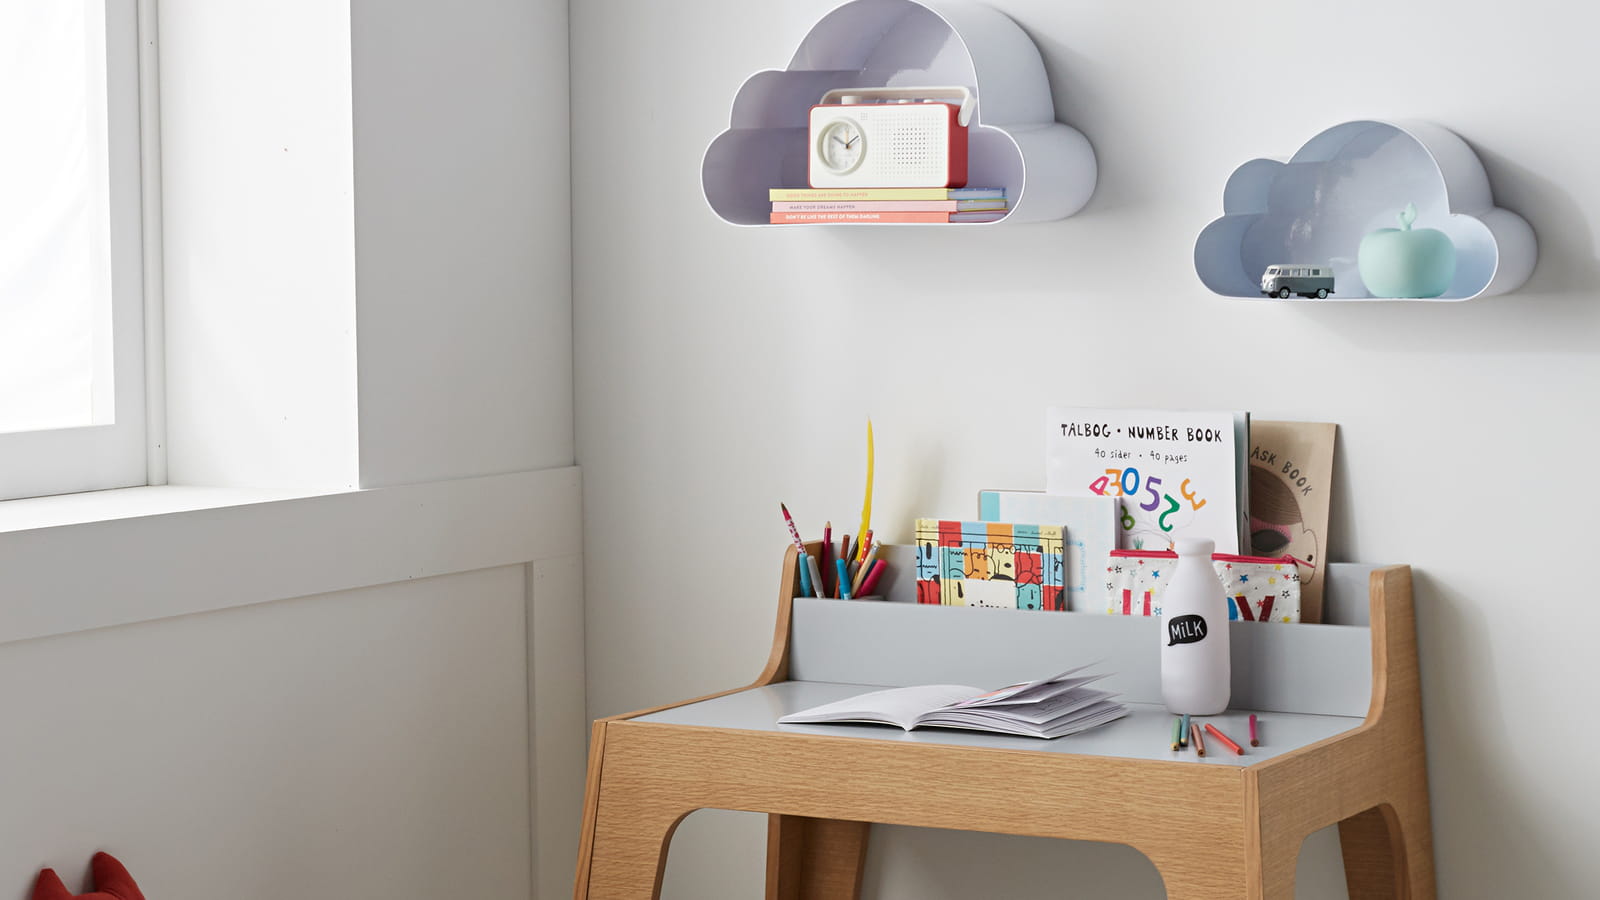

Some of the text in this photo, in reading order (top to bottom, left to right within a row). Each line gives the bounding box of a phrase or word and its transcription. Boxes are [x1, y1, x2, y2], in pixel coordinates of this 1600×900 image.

[1061, 423, 1222, 443] TALBOG NUMBER BOOK
[1095, 448, 1188, 464] 40 sider 40 pages
[1251, 446, 1313, 496] ASK BOOK
